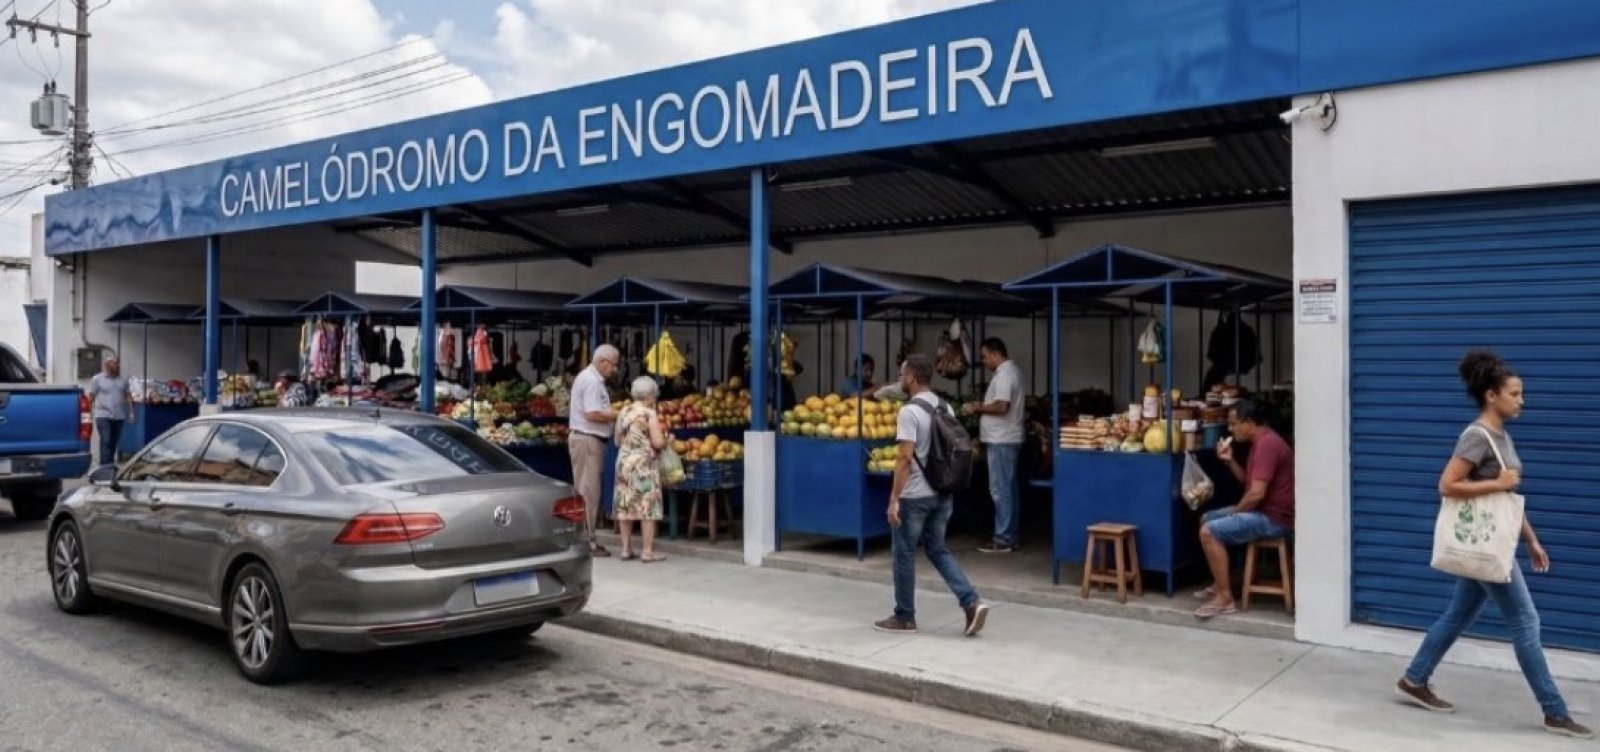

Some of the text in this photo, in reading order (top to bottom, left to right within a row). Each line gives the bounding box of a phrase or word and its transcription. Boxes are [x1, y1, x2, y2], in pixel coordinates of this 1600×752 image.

[220, 28, 1053, 217] CAMELÓDROMO DA ENGOMADEIRA
